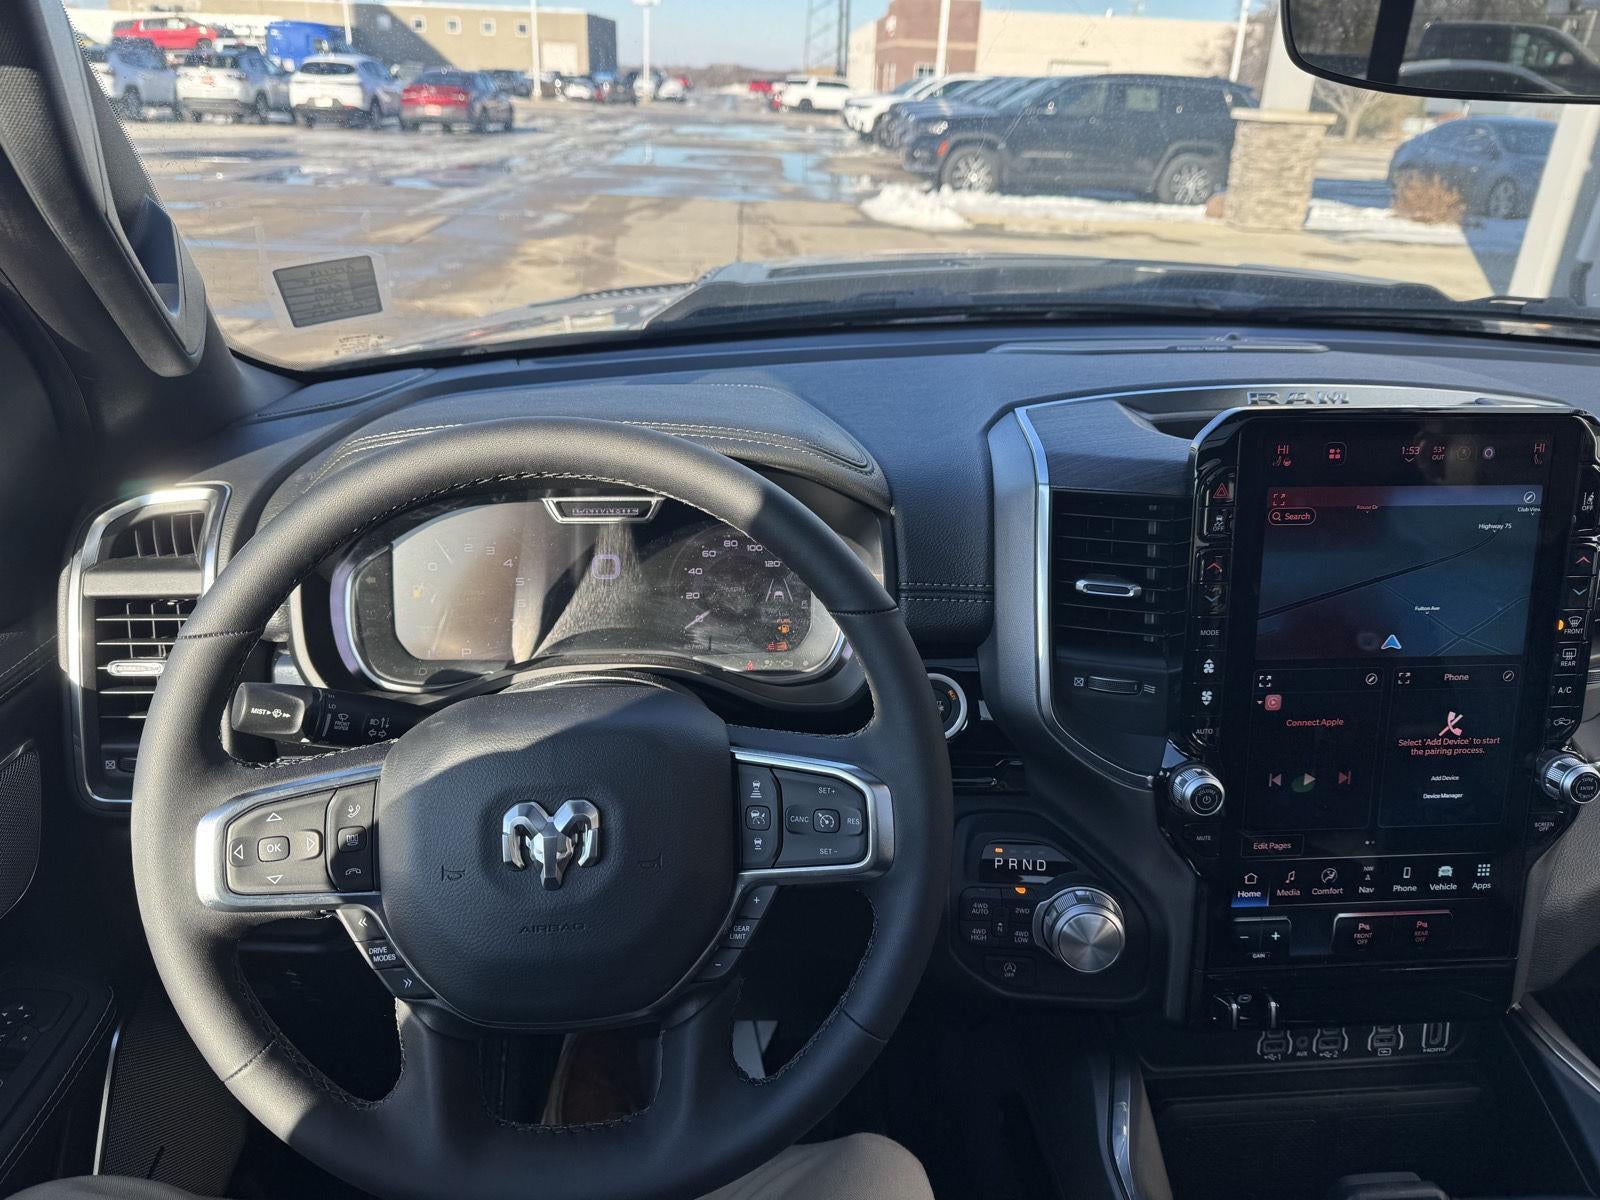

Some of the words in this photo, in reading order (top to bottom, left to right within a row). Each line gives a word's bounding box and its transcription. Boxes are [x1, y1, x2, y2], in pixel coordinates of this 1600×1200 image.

[1247, 391, 1350, 405] RAM
[1277, 444, 1289, 455] HI
[1402, 446, 1421, 455] 1:53
[1534, 443, 1546, 453] HI
[1284, 512, 1311, 520] Search
[1478, 523, 1504, 531] Highway
[723, 539, 738, 548] 80
[747, 544, 763, 552] 100
[702, 550, 717, 558] 60
[503, 558, 513, 568] 4
[764, 560, 781, 568] 120
[688, 567, 703, 575] 40
[685, 592, 700, 600] 20
[1444, 673, 1469, 681] Phone
[1557, 686, 1572, 694] A/C
[250, 707, 267, 716] MIST
[1286, 718, 1320, 727] Connect
[1320, 718, 1344, 727] Apple
[1398, 739, 1422, 747] Select
[1411, 748, 1424, 756] the
[1425, 747, 1452, 757] pairing
[1454, 747, 1485, 756] process.
[1440, 792, 1463, 800] Manager
[790, 815, 809, 823] CANC
[847, 817, 860, 825] RES
[266, 843, 282, 853] OK
[1253, 842, 1268, 850] Edit
[1269, 842, 1292, 851] Pages
[1358, 886, 1375, 894] Nav
[1392, 884, 1418, 892] Phone
[1429, 883, 1458, 891] Vehicle
[1471, 882, 1492, 891] Apps
[1237, 890, 1262, 898] Home
[1276, 889, 1301, 897] Media
[1311, 887, 1344, 895] Comfort
[519, 922, 586, 935] AIRBAG
[368, 946, 388, 955] DRIVE
[373, 953, 397, 962] MODES
